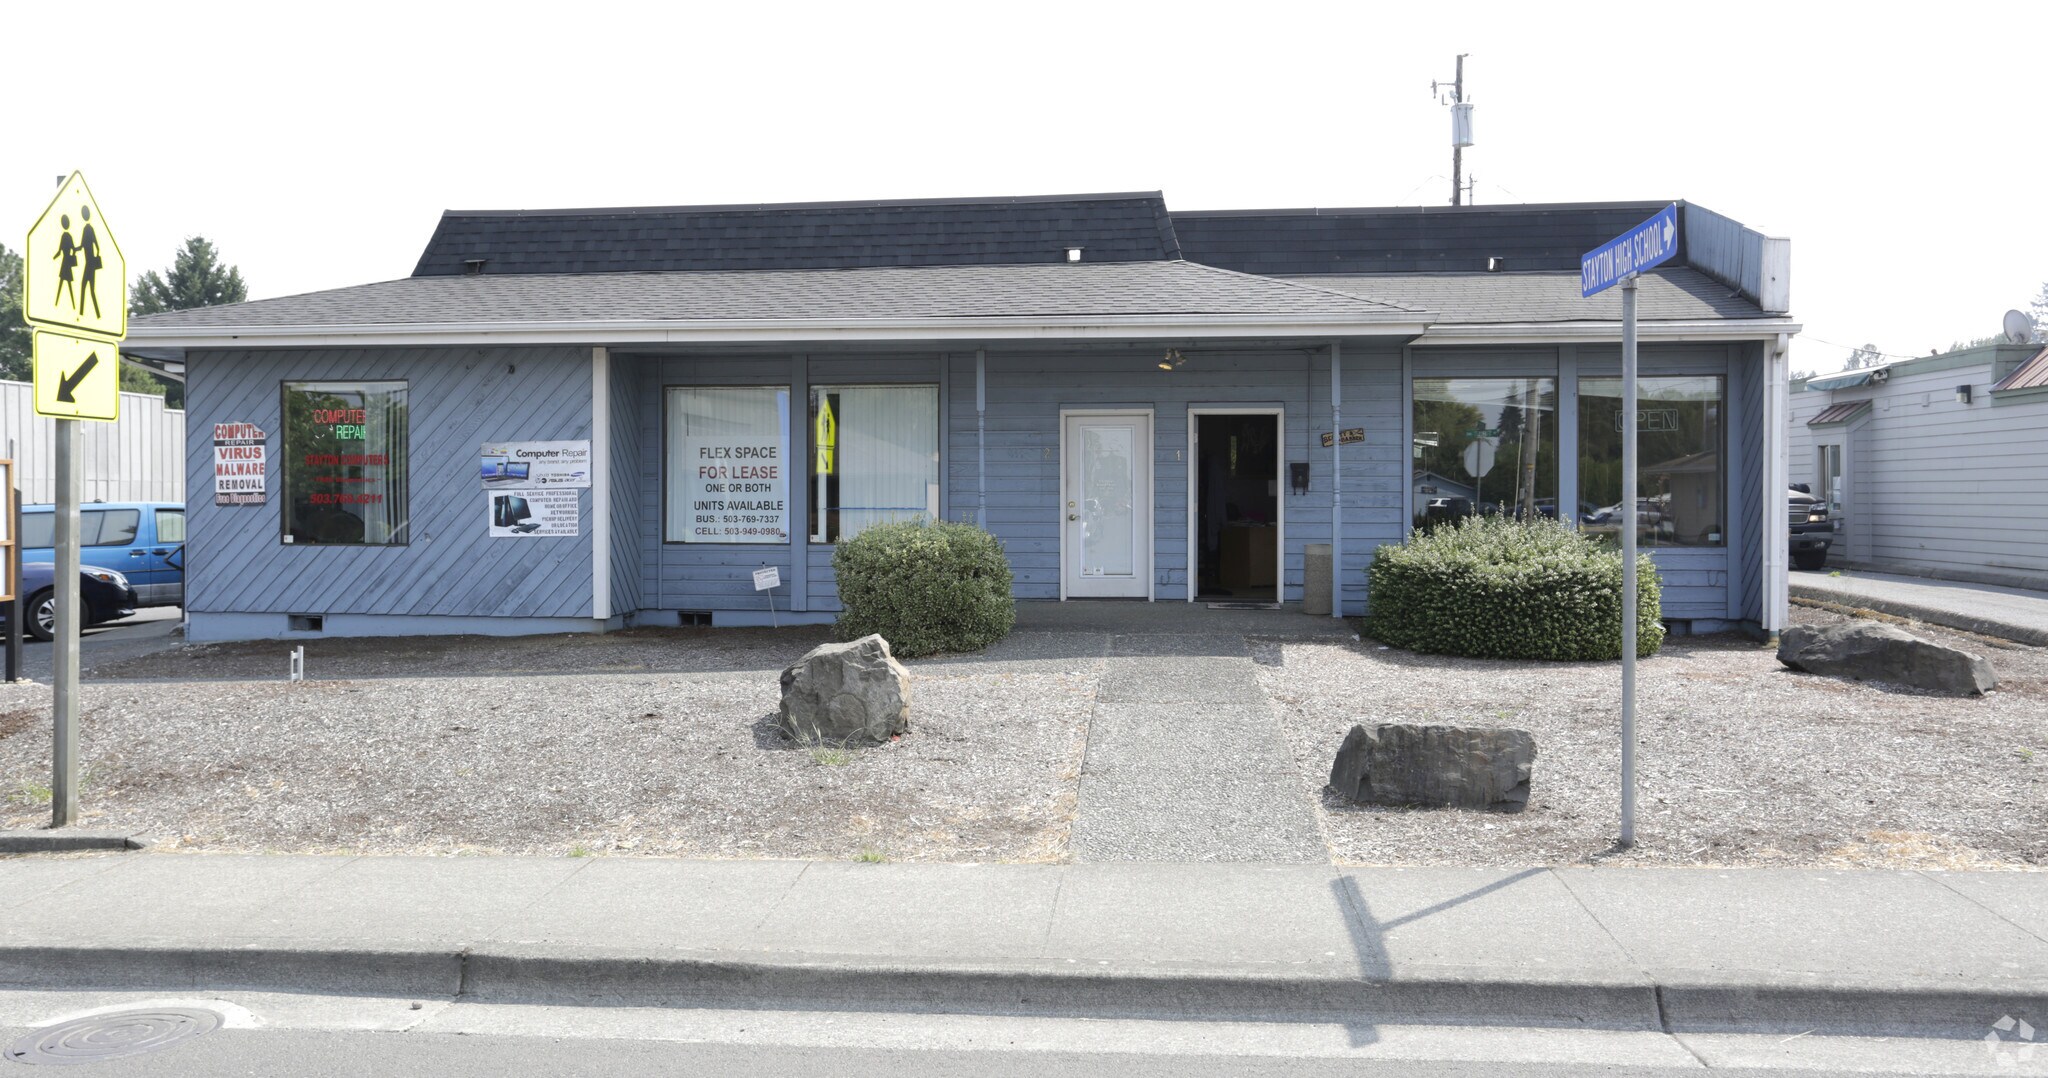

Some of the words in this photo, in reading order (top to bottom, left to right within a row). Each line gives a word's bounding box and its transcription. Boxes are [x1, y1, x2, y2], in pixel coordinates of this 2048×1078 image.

[1583, 248, 1614, 292] STAYTON
[1615, 238, 1632, 277] HIGH
[1634, 220, 1663, 268] SCHOOL
[219, 447, 262, 459] VIRUS
[516, 449, 559, 459] Computer
[562, 448, 587, 458] Repair
[700, 447, 731, 459] FLEX
[735, 447, 776, 458] SPACE
[216, 463, 265, 476] MALWARE
[700, 466, 728, 479] FOR
[733, 466, 778, 479] LEASE
[220, 479, 262, 490] REMOVAL
[705, 484, 725, 492] ONE
[728, 484, 742, 492] OR
[745, 484, 771, 492] BOTH
[216, 494, 229, 503] Free
[694, 501, 724, 510] UNITS
[727, 501, 783, 510] AVAILABLE
